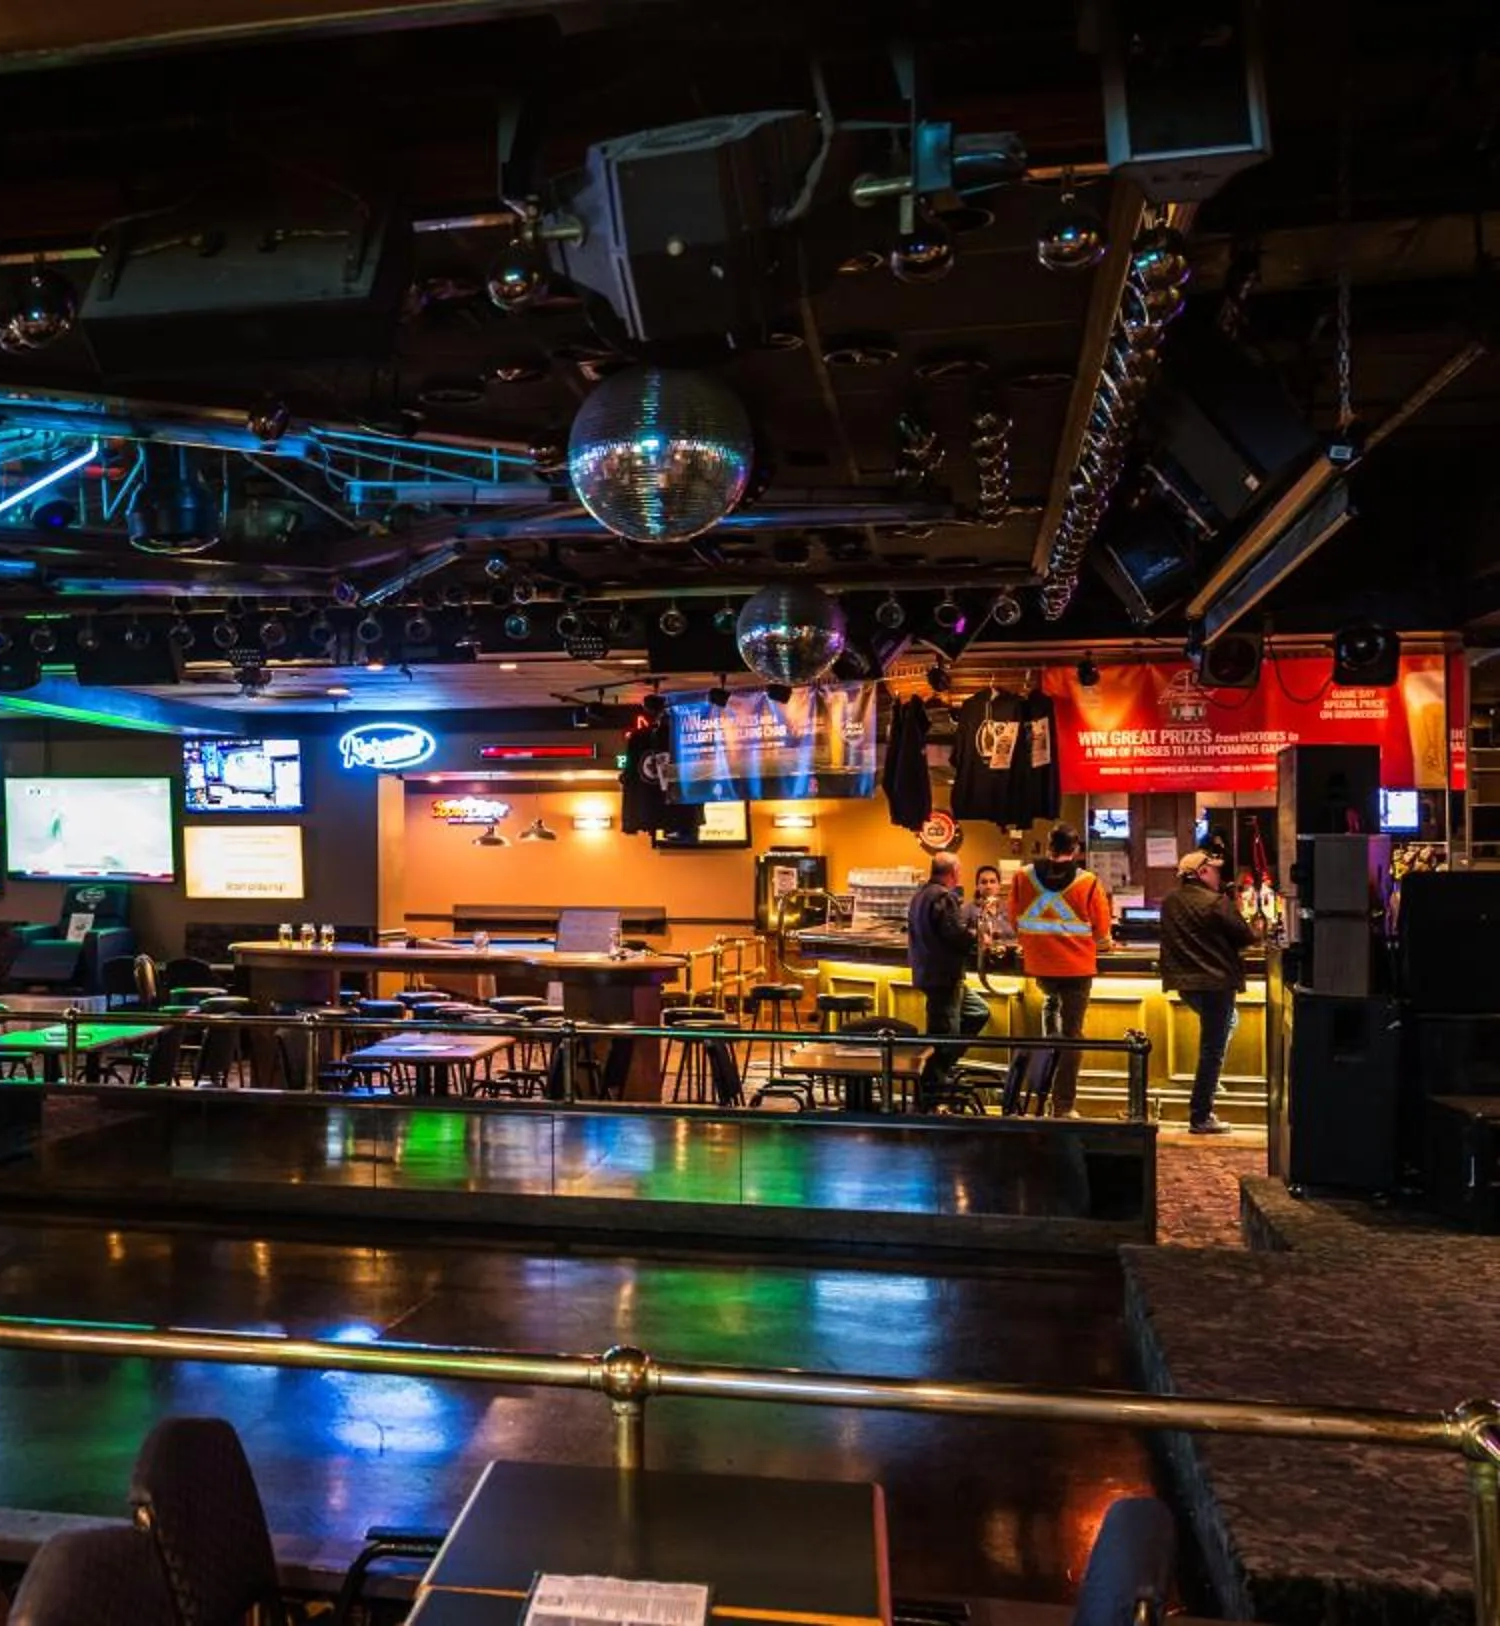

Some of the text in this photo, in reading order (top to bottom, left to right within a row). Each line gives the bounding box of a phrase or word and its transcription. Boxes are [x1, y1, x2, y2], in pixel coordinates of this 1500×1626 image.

[1078, 730, 1108, 746] WIN
[1110, 729, 1157, 746] GREAT
[1160, 728, 1212, 745] PRIZES
[1288, 732, 1299, 742] to
[1085, 747, 1093, 758] A
[1133, 745, 1170, 757] PASSES
[1172, 745, 1185, 756] TO
[1187, 745, 1201, 755] AN
[1203, 744, 1259, 755] UPCOMING
